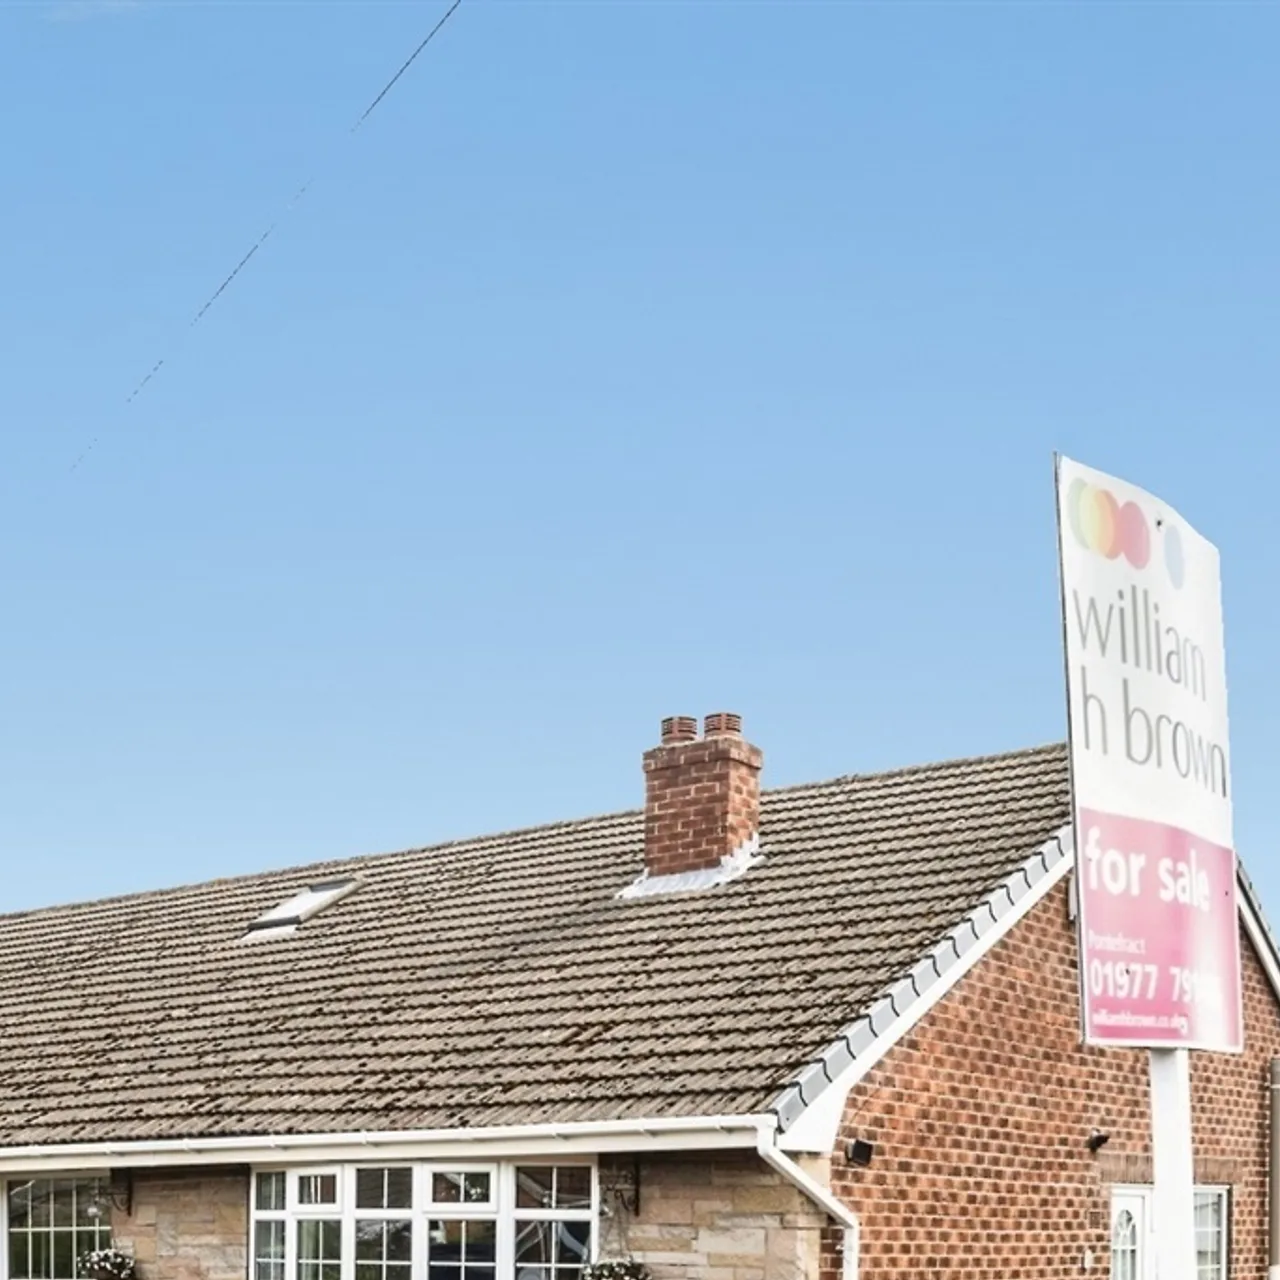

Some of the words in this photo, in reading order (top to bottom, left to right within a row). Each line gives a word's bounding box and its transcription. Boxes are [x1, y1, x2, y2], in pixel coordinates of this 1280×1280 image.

[1072, 584, 1207, 702] william
[1081, 664, 1108, 756] h
[1122, 677, 1228, 799] brown
[1085, 825, 1147, 897] for
[1157, 848, 1210, 913] sale
[1090, 958, 1159, 999] 01977
